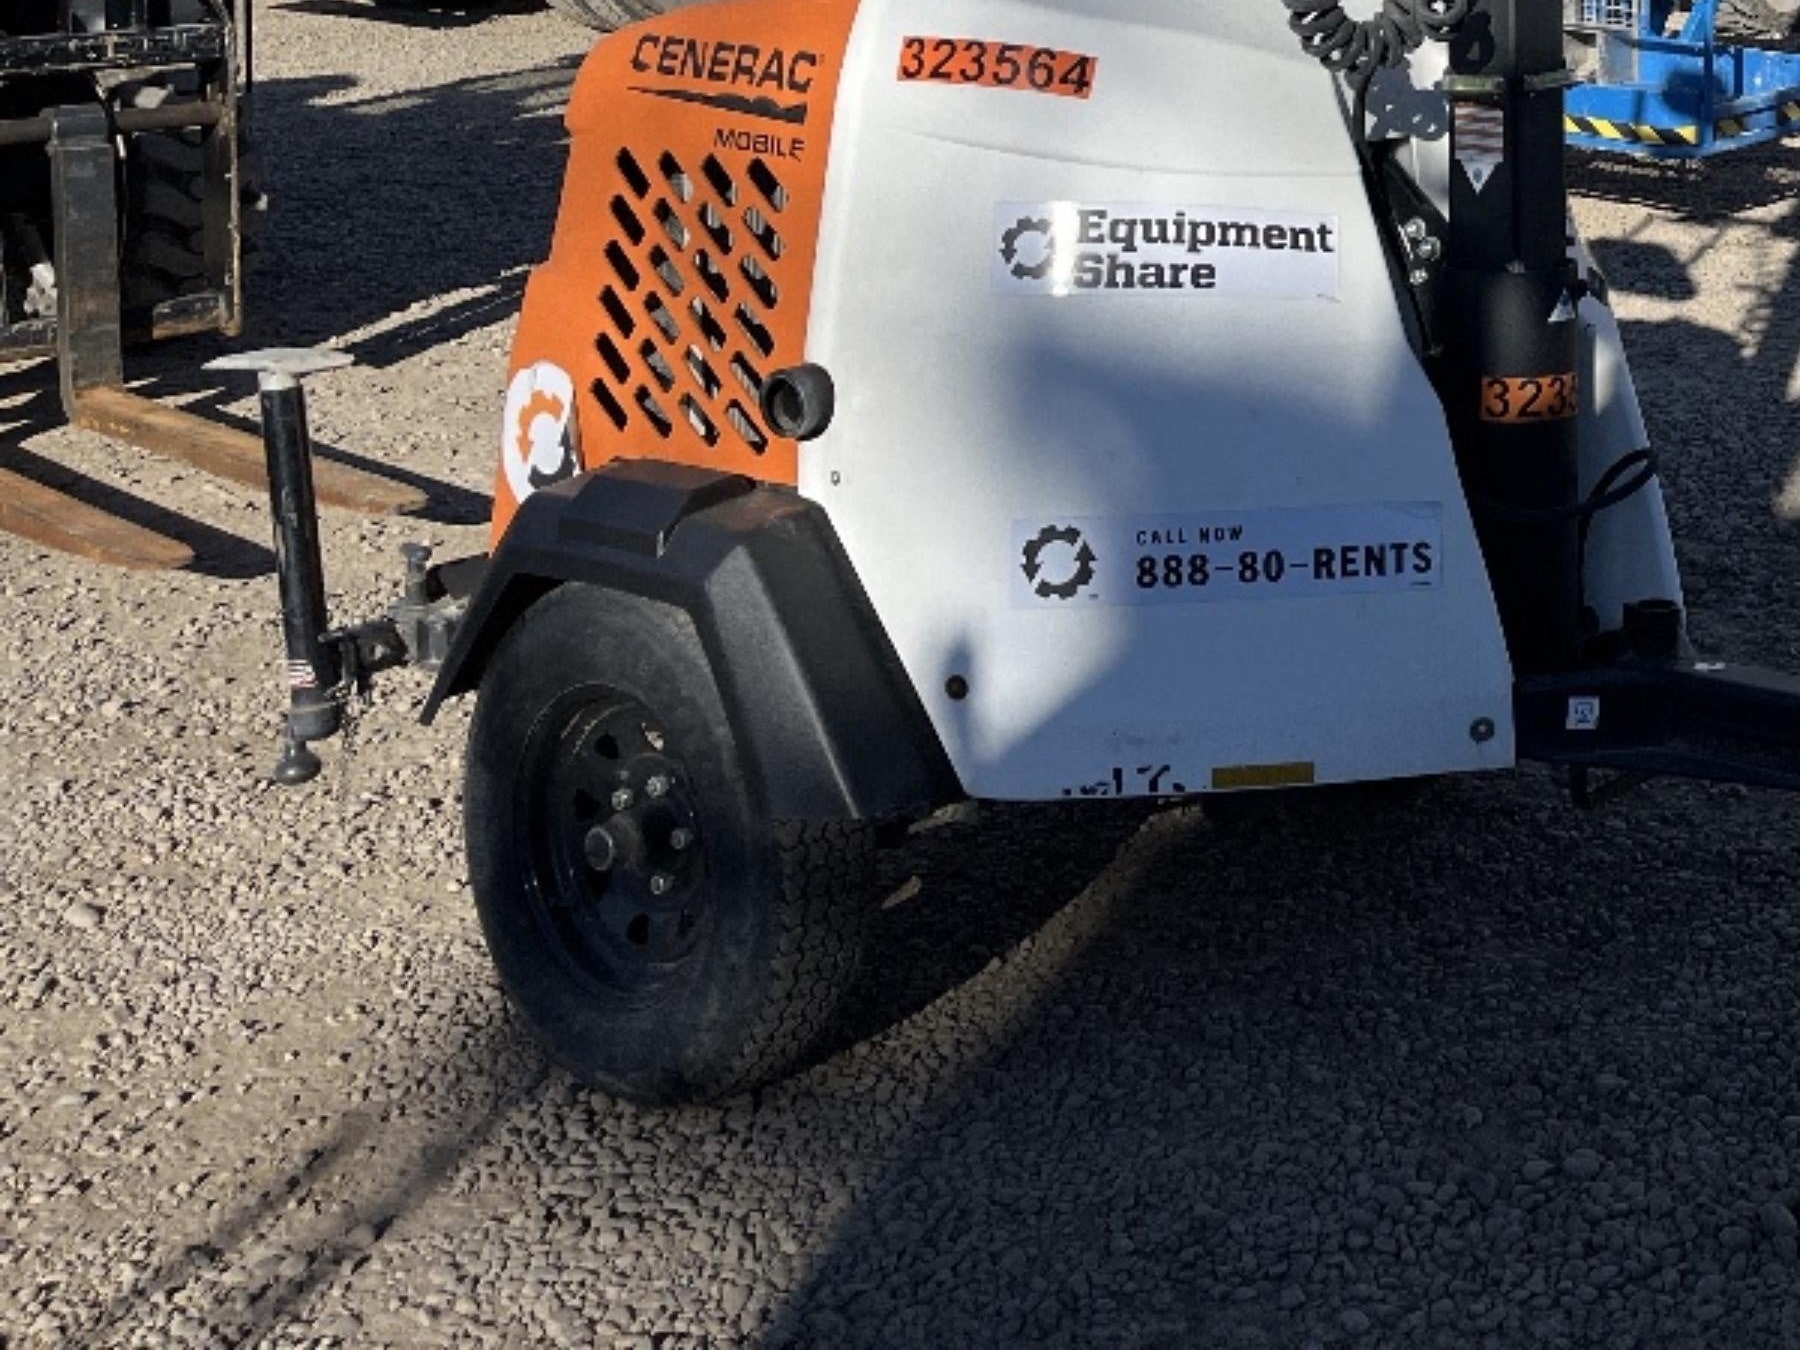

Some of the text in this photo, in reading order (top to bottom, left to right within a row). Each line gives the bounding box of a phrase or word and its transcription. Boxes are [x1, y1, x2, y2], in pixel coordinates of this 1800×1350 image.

[902, 38, 1090, 94] 323564
[713, 127, 805, 163] MOBILE
[1075, 209, 1336, 253] Equipment
[1073, 253, 1217, 290] Share
[1136, 524, 1244, 546] CALL NOW
[1135, 541, 1433, 589] 888-80-RENTS
